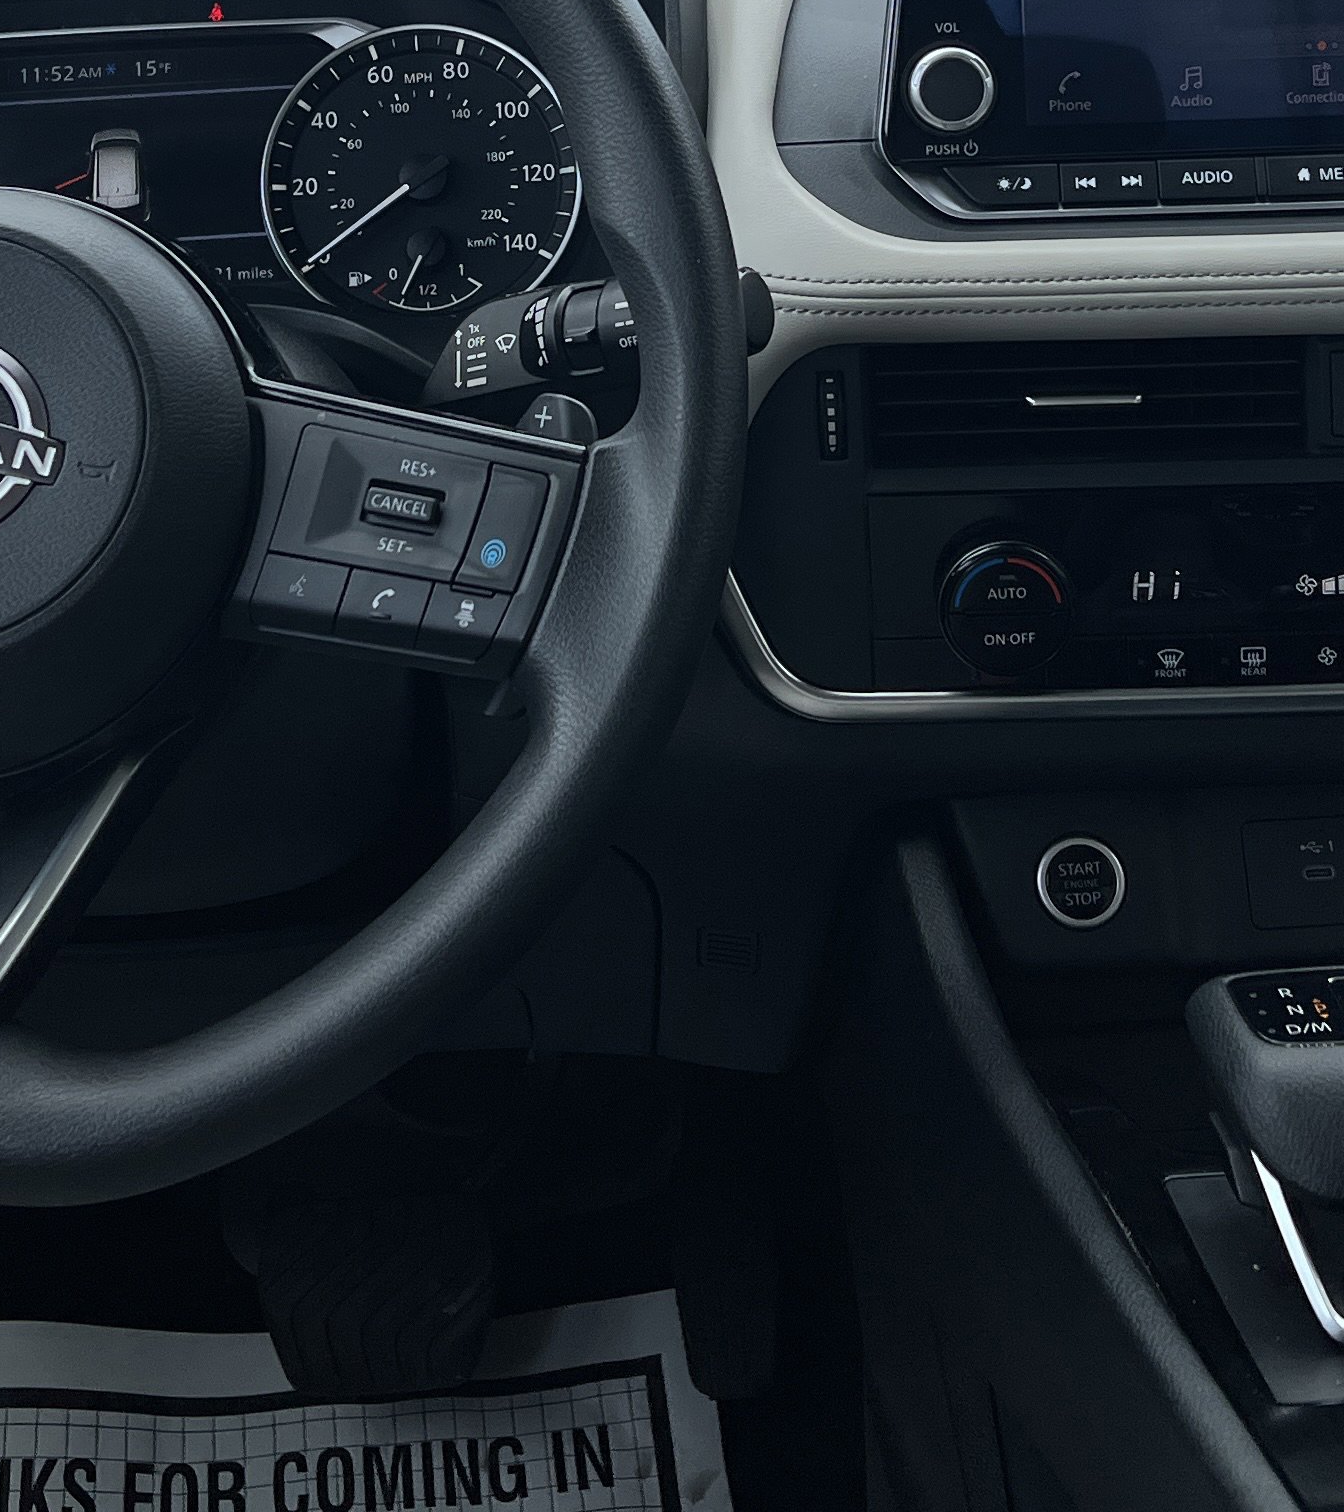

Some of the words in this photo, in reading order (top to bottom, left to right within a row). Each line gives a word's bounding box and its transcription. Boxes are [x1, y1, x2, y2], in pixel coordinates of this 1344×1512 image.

[934, 22, 960, 34] VOL
[20, 65, 75, 84] 11:52
[78, 67, 102, 79] AM
[367, 66, 394, 84] 60
[442, 62, 470, 80] 80
[404, 72, 433, 84] MPH
[1049, 98, 1092, 112] Phone
[1170, 93, 1213, 107] Audio
[389, 102, 410, 114] 100
[451, 108, 471, 120] 140
[495, 100, 530, 119] 100
[311, 111, 338, 129] 40
[347, 138, 362, 150] 60
[925, 143, 960, 155] PUSH
[486, 151, 506, 163] 180
[522, 164, 555, 182] 120
[1181, 170, 1233, 185] AUDIO
[292, 178, 318, 196] 20
[340, 198, 355, 210] 20
[481, 209, 502, 220] 220
[467, 235, 496, 249] km/h
[503, 233, 537, 252] 140
[237, 268, 274, 280] miles
[388, 268, 398, 281] 0
[419, 284, 438, 296] 1/2
[467, 336, 486, 349] OFF
[619, 336, 638, 348] OFF
[400, 458, 437, 477] RES+
[370, 493, 428, 517] CANCEL
[987, 587, 1027, 600] AUTO
[1154, 668, 1187, 678] FRONT
[1240, 666, 1267, 676] REAR
[1328, 840, 1334, 852] 1
[1058, 861, 1101, 877] START
[1063, 878, 1099, 889] ENGINE
[1065, 891, 1102, 906] STOP
[1277, 988, 1294, 999] R
[1286, 1004, 1305, 1016] N
[1285, 1022, 1332, 1036] D/M
[124, 1461, 247, 1512] FOR
[273, 1435, 530, 1512] COMING
[552, 1423, 616, 1494] IN
